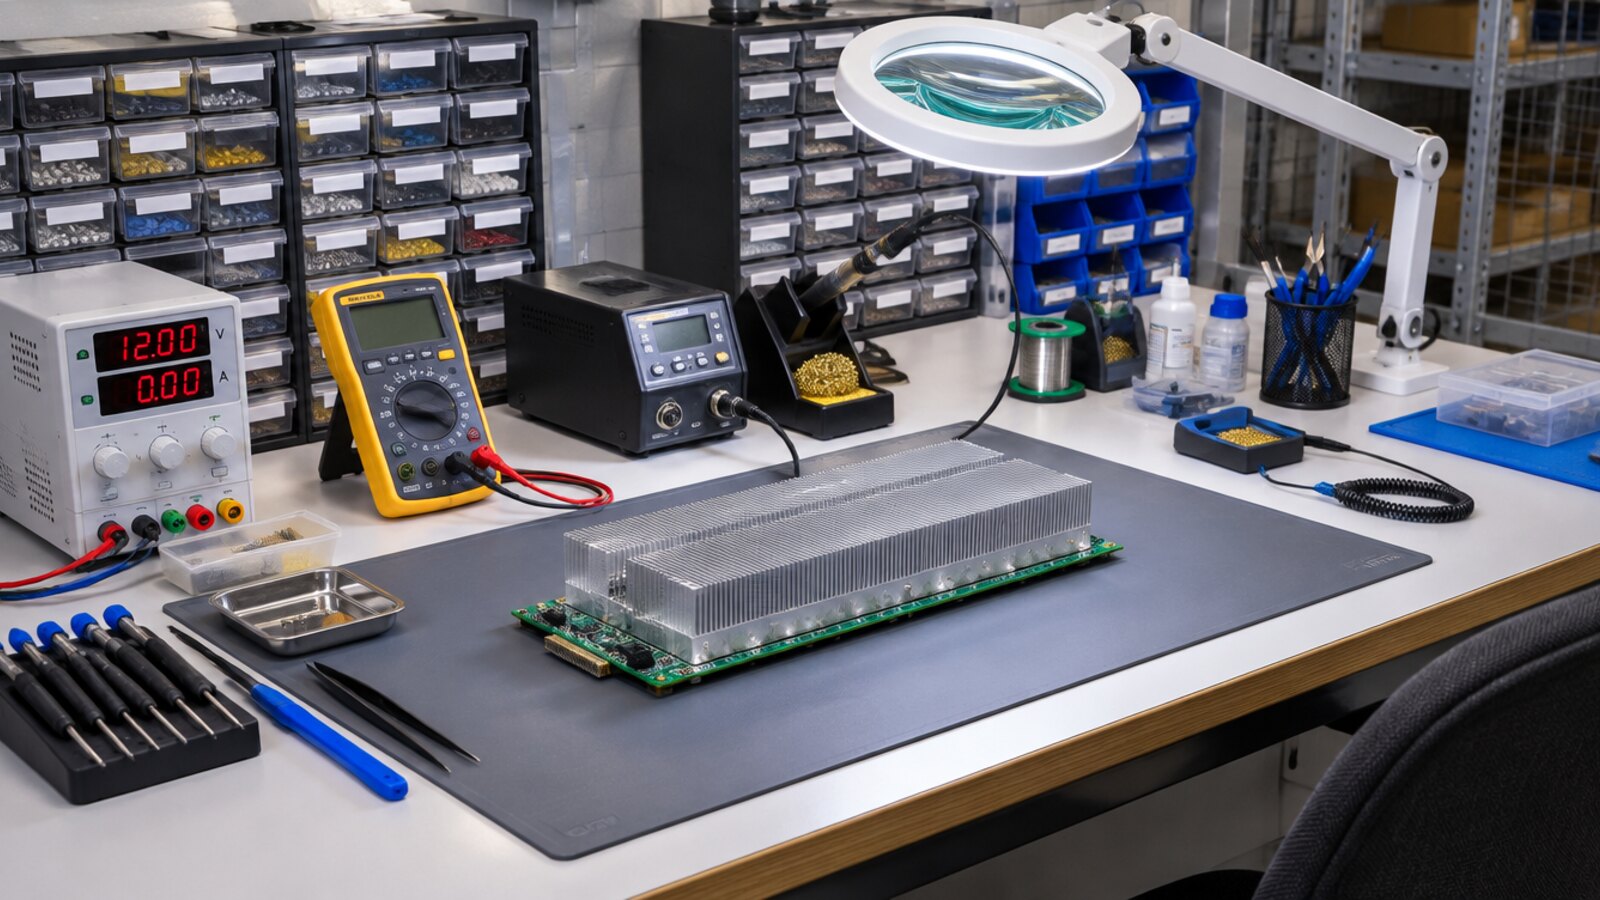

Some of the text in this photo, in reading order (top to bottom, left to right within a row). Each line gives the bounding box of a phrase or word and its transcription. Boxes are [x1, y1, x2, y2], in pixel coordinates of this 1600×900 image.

[123, 324, 196, 360] 12.00
[215, 328, 225, 340] V
[137, 367, 200, 404] 0.00
[219, 371, 229, 383] A
